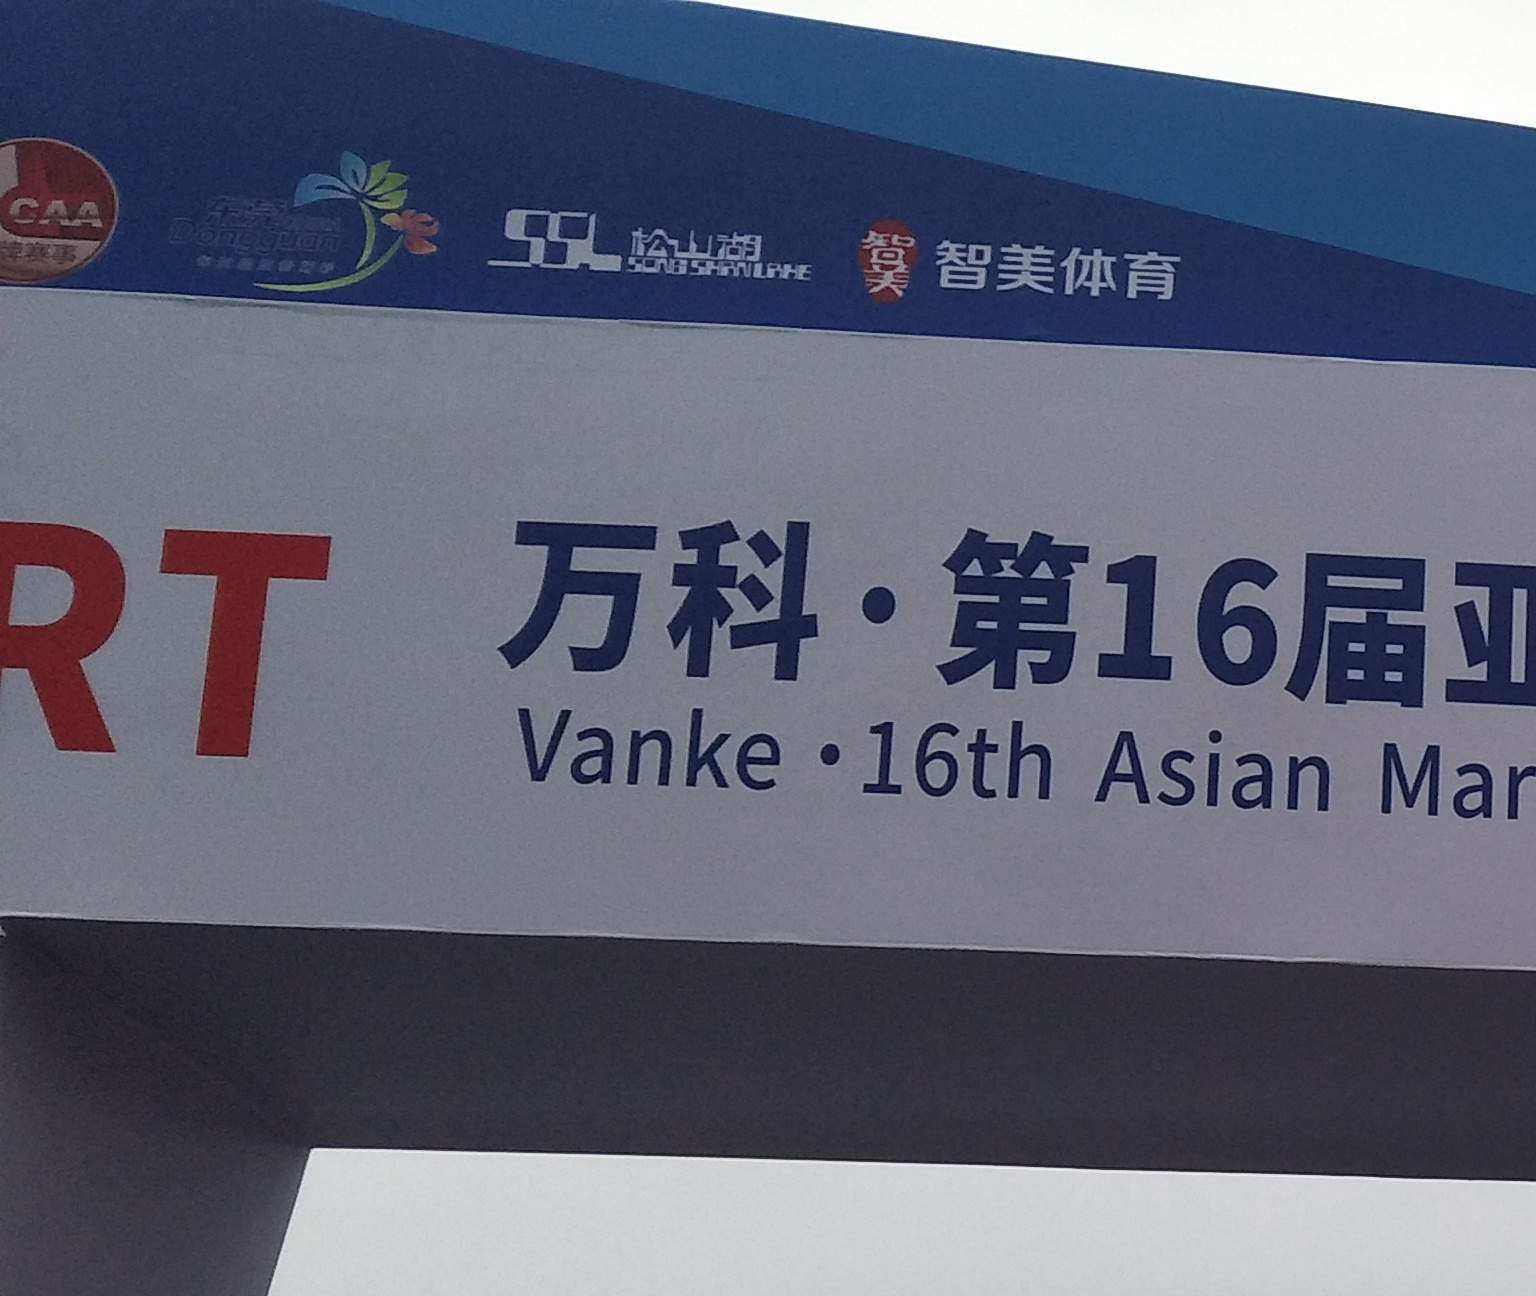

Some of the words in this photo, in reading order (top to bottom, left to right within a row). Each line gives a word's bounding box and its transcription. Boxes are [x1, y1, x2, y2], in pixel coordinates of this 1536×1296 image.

[8, 198, 104, 229] CAA
[631, 226, 763, 263] 松山湖
[934, 239, 1182, 301] 智美体育
[0, 520, 332, 758] RT
[517, 707, 781, 791] Vanke
[861, 720, 1052, 800] 16th
[1094, 730, 1330, 812] Asian
